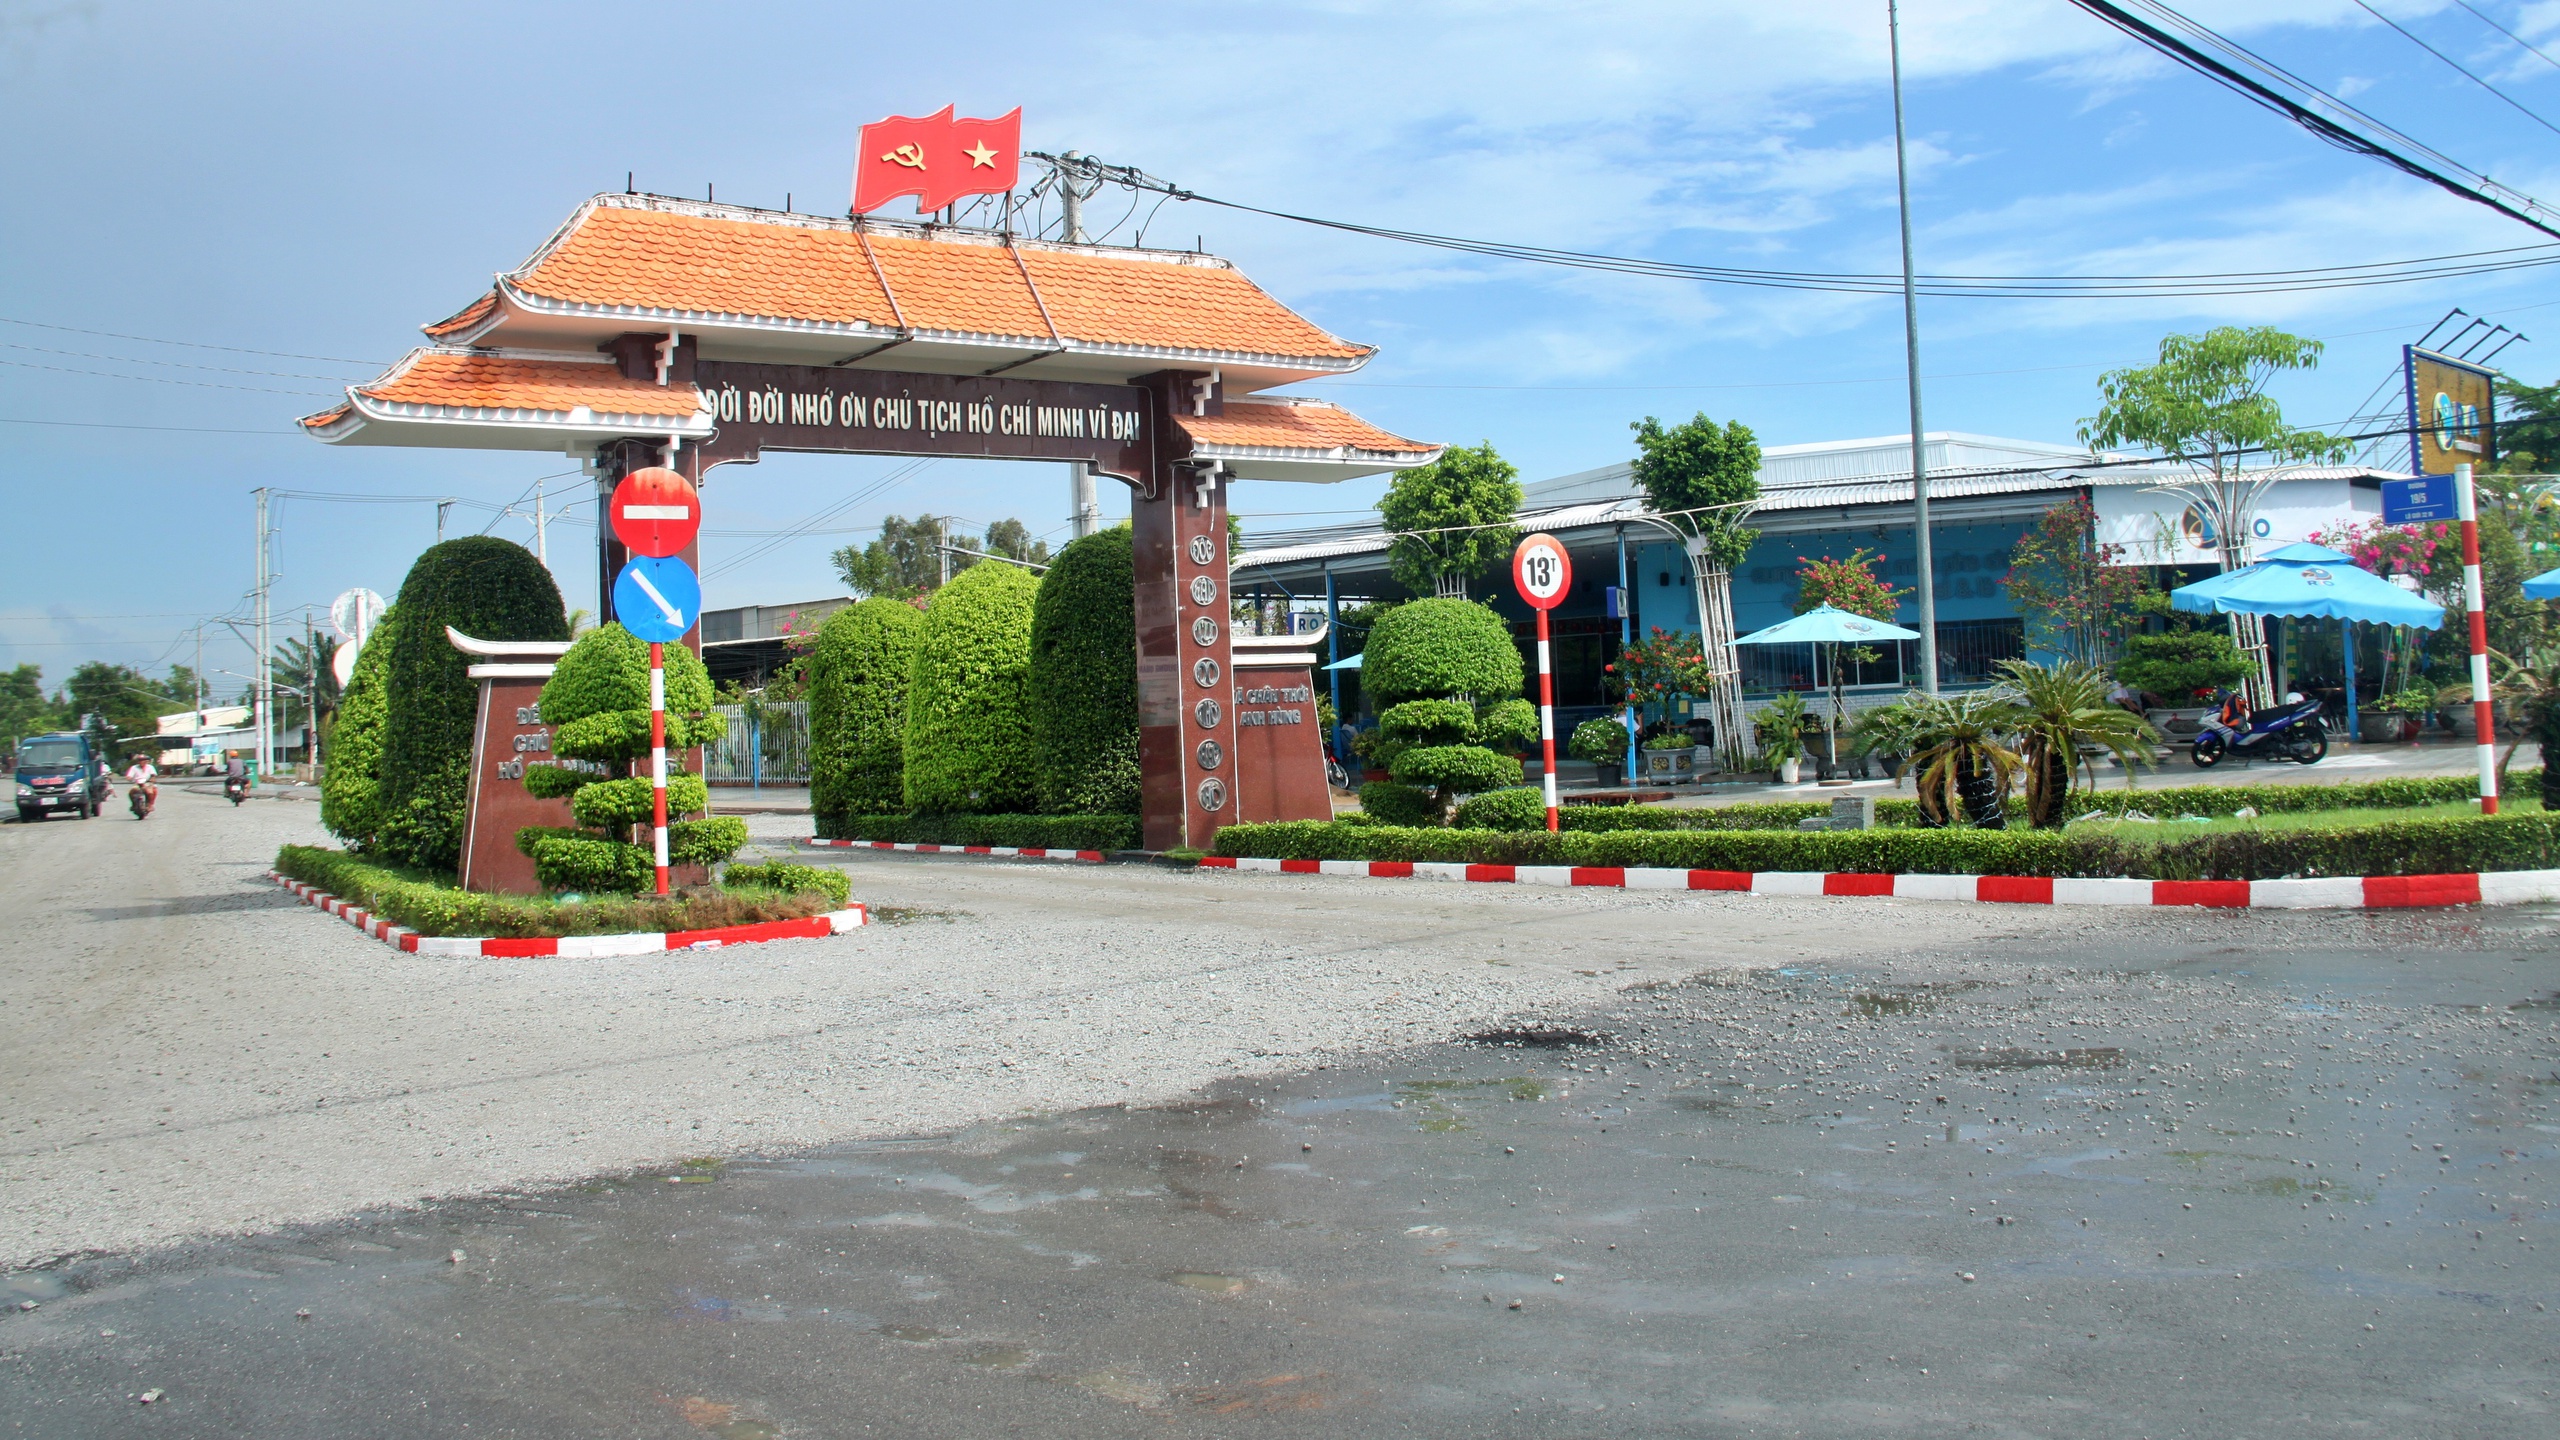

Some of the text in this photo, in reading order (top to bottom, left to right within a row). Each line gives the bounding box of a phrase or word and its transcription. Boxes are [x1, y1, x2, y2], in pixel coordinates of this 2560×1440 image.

[748, 384, 783, 424] ĐỜI
[792, 387, 834, 427] NHỚ
[840, 391, 866, 428] ƠN
[873, 389, 912, 430] CHỦ
[917, 400, 962, 439] TỊCH
[968, 394, 994, 435] HỒ
[1000, 398, 1031, 436] CHÍ
[1037, 406, 1084, 438] MINH
[1088, 403, 1108, 439] VĨ
[1111, 411, 1140, 447] ĐẠI
[2410, 492, 2427, 505] 19/5
[1299, 618, 1319, 631] RIO
[1234, 686, 1244, 704] Ã
[1240, 706, 1302, 726] ANH HÙNG
[513, 728, 549, 752] CHỦ
[497, 754, 523, 780] HỒ
